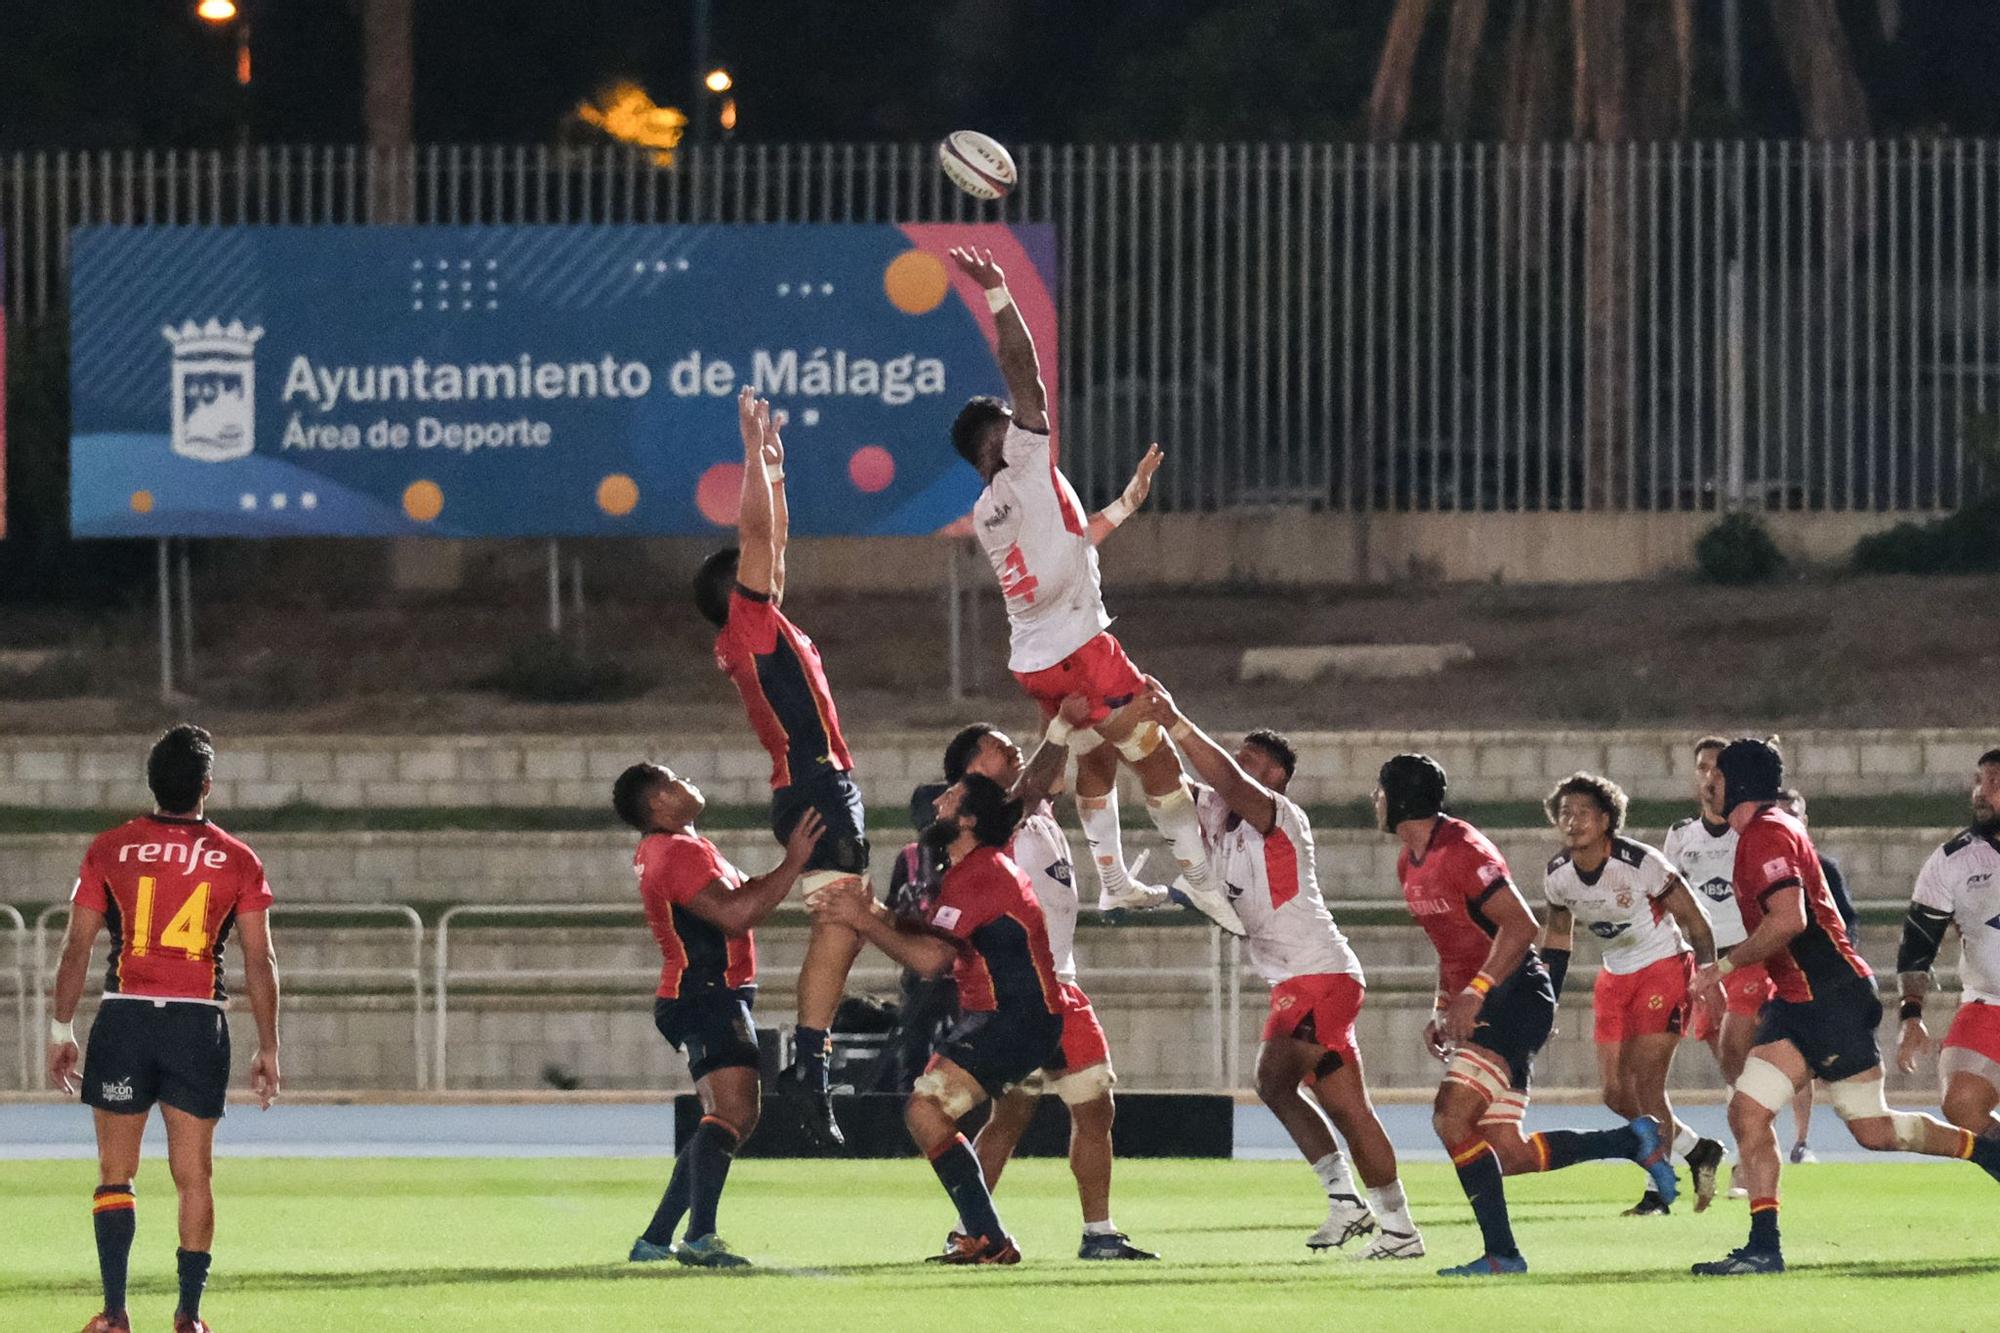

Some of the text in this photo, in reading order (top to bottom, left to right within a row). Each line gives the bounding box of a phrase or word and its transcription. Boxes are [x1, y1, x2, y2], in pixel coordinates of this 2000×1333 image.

[283, 347, 945, 411] Ayuntamiento de Málaga
[282, 411, 552, 453] Área de Deporte
[1001, 541, 1040, 604] 4
[118, 837, 228, 875] renfe
[131, 876, 212, 961] 14
